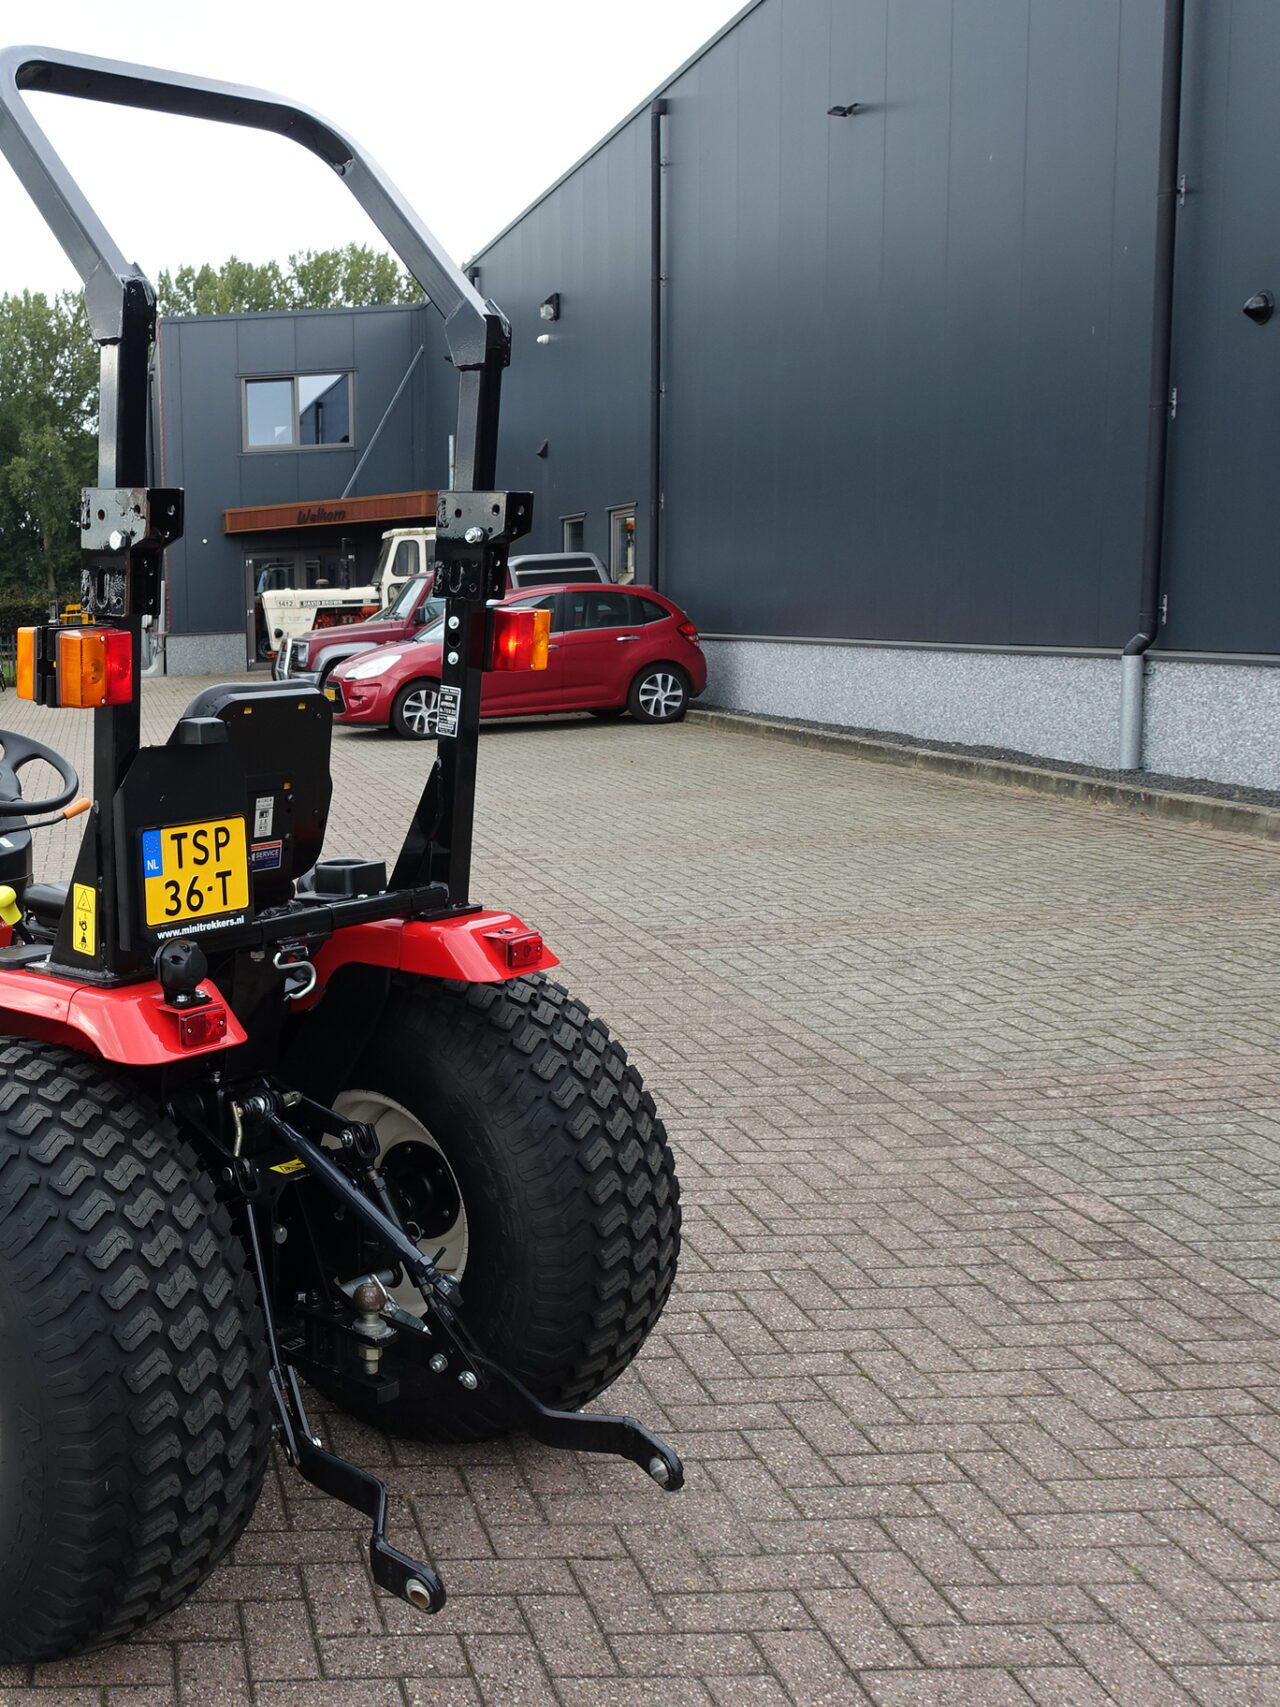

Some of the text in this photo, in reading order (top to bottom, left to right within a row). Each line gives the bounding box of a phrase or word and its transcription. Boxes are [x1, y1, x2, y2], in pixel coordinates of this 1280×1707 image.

[170, 826, 231, 869] TSP
[256, 849, 279, 859] SERVICE
[147, 859, 159, 871] NL
[157, 915, 245, 939] www.minitrekkers.nl
